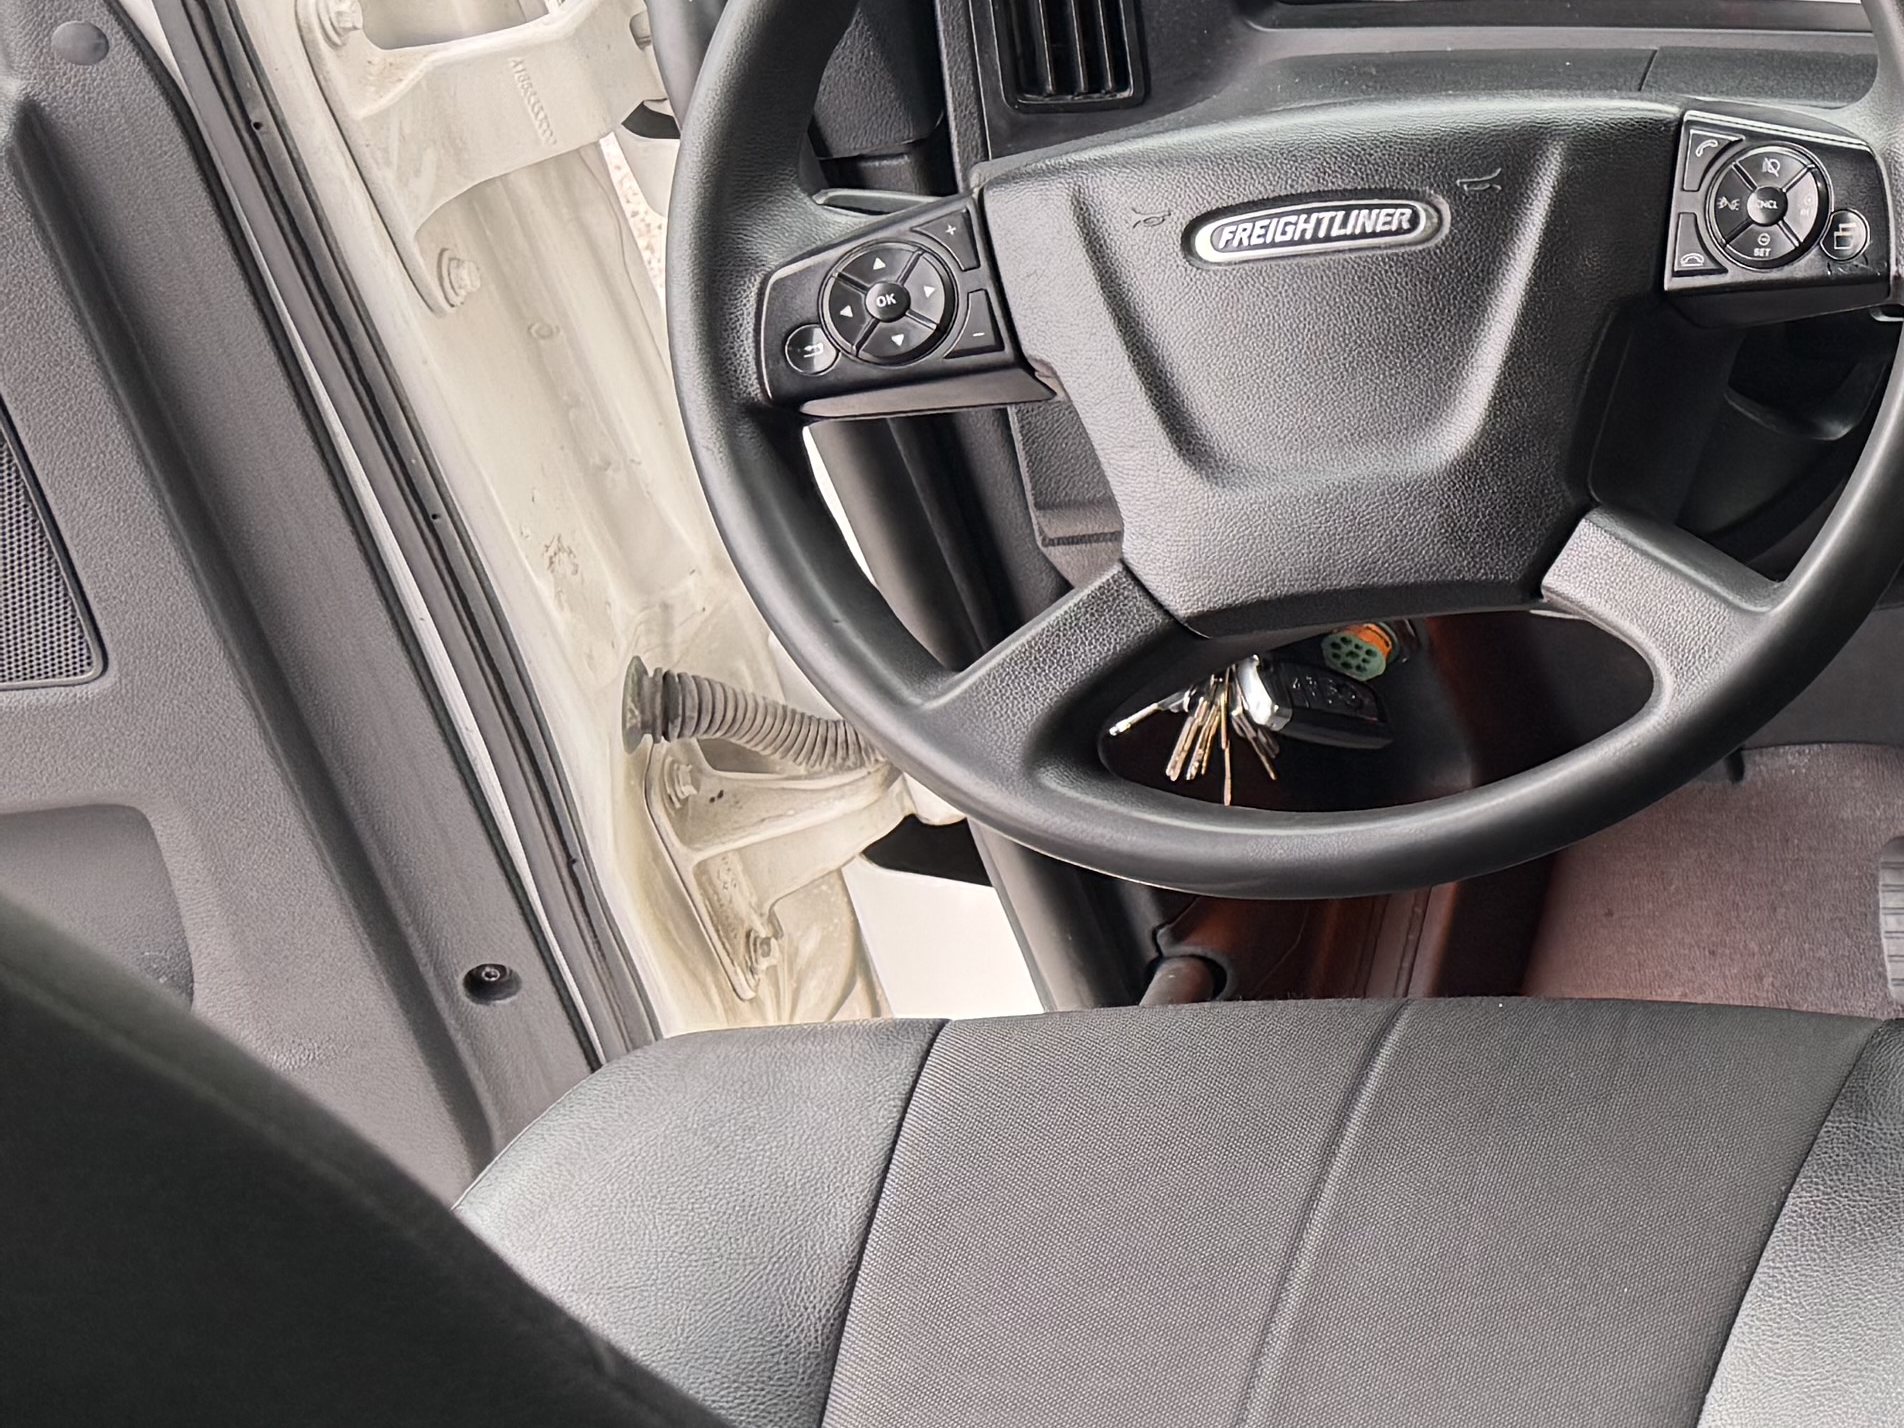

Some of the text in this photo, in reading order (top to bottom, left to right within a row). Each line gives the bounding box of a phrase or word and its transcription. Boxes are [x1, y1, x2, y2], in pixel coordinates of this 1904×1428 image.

[1217, 207, 1413, 250] FREIGHTLINER
[1753, 247, 1771, 258] SET
[876, 294, 897, 308] OK
